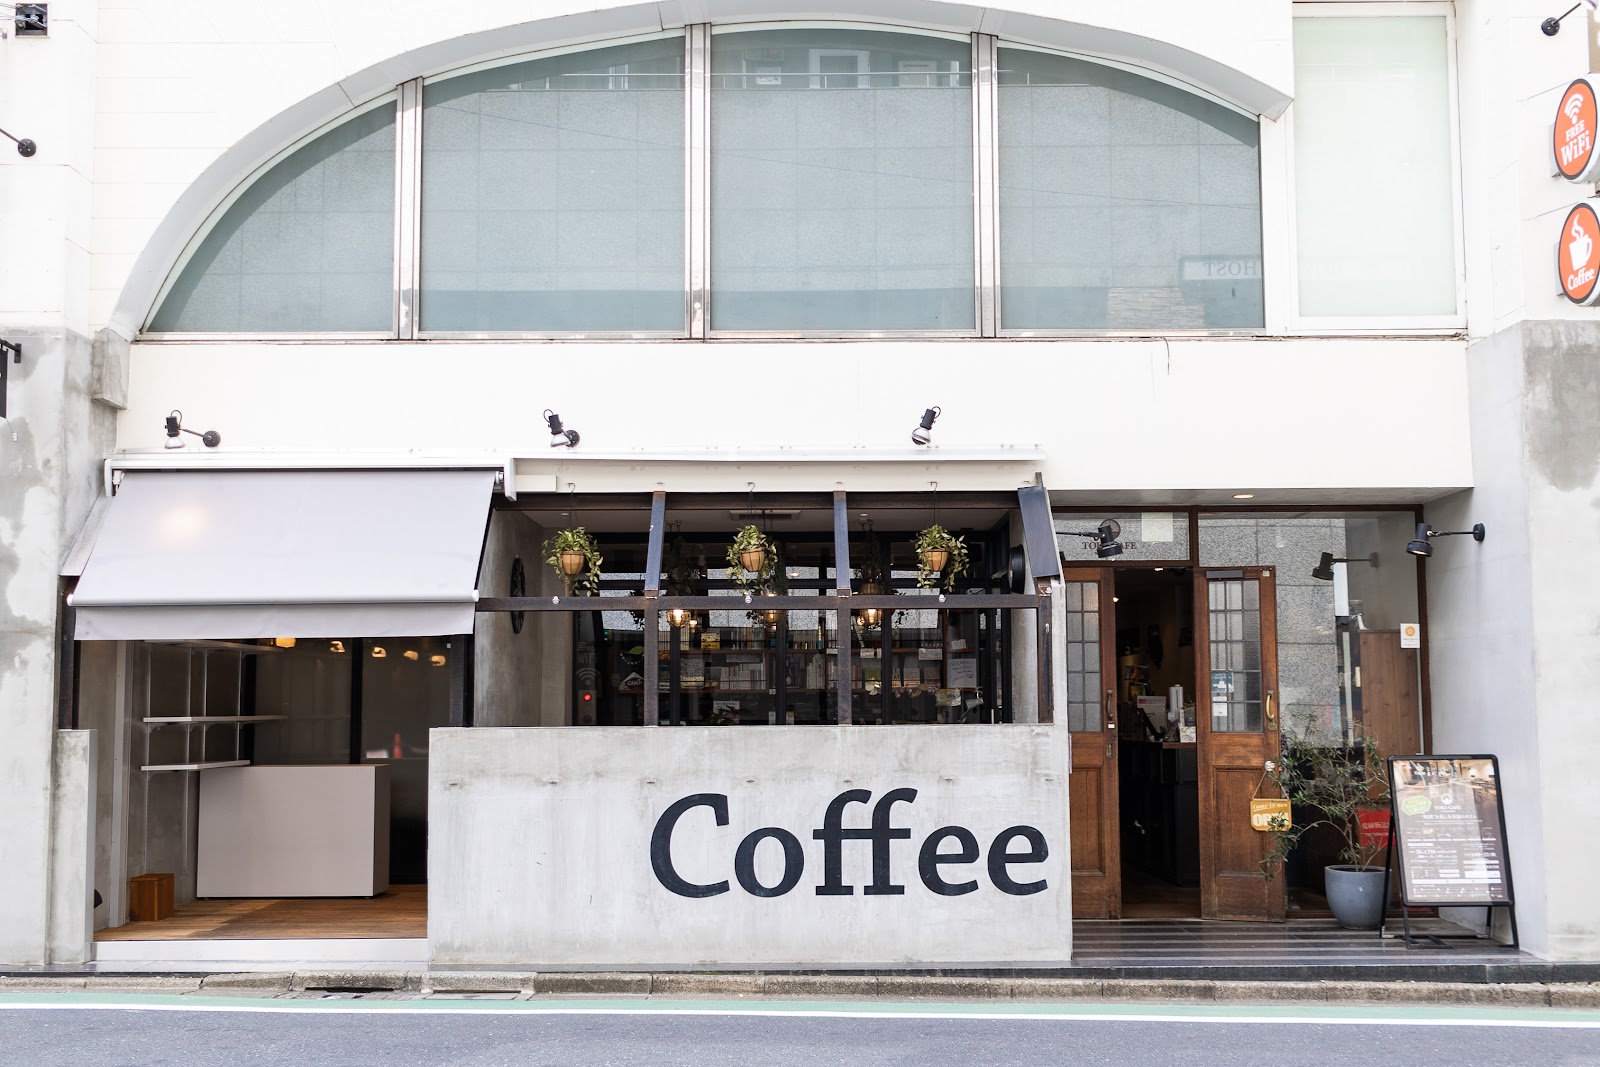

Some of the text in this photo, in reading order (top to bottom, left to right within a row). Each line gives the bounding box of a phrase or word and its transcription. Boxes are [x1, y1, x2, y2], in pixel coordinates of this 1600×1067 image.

[1565, 119, 1586, 142] FREE
[1560, 130, 1592, 167] WiFi
[1567, 267, 1596, 292] Coffee
[650, 787, 1049, 899] Coffee
